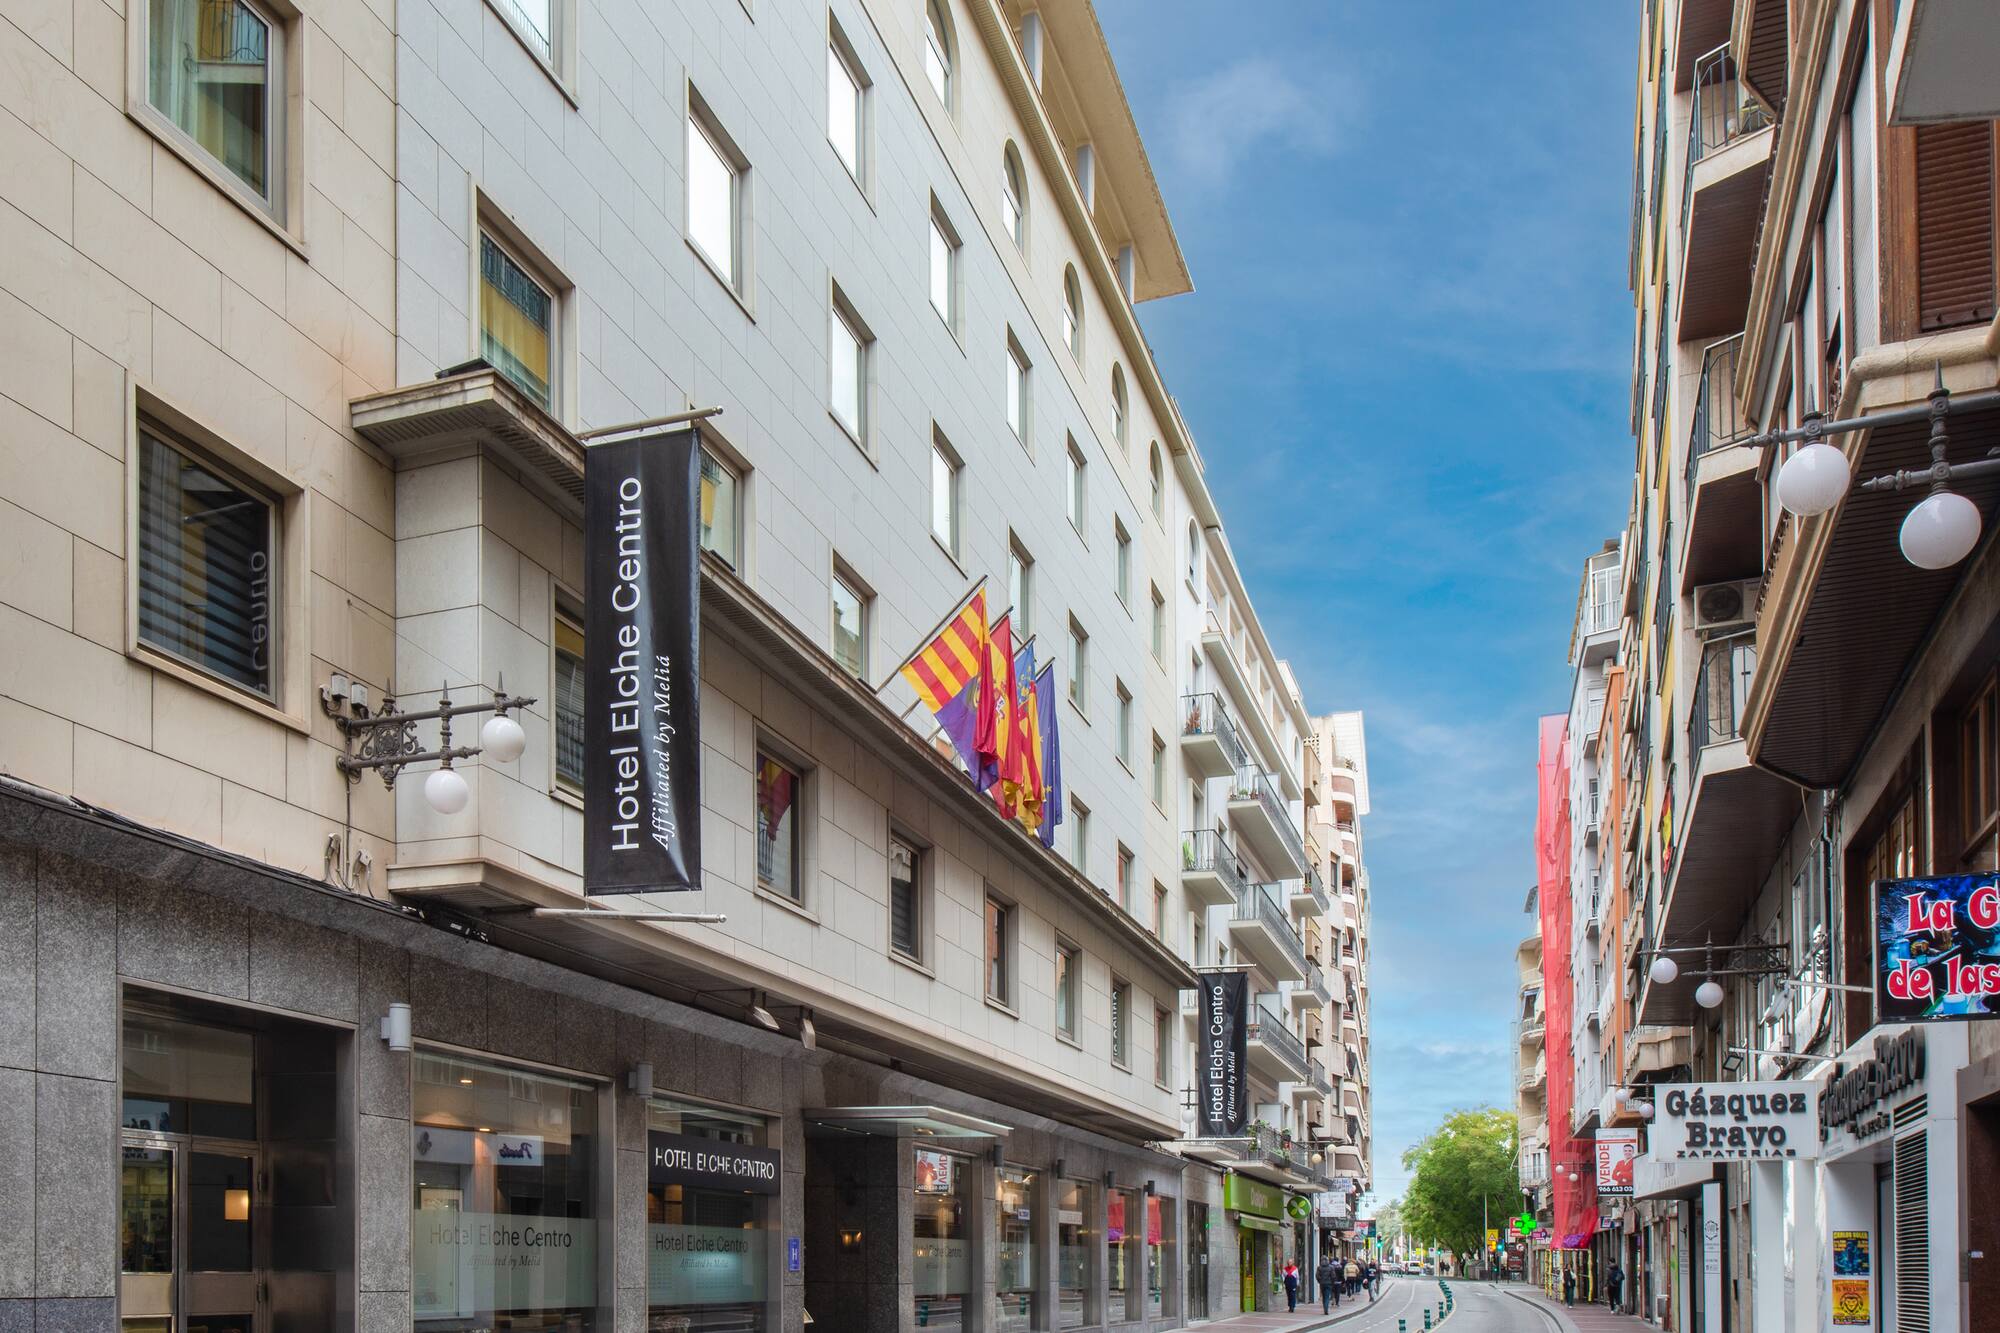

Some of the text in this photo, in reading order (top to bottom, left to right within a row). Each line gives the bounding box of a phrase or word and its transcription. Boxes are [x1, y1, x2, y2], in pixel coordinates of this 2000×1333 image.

[610, 477, 642, 851] Hotel Elche Centro
[651, 655, 676, 850] Affiliated by Meliá
[1902, 891, 1957, 938] La
[1887, 954, 2000, 1006] de las
[1210, 986, 1223, 1122] Hotel Elche Centro
[1665, 1087, 1806, 1121] Gázquez
[1685, 1121, 1786, 1147] Bravo
[655, 1147, 775, 1180] HOTEL ELCHE CENTRO
[1600, 1145, 1610, 1184] VENDE
[430, 1223, 572, 1248] Hotel Elche Centro
[656, 1233, 749, 1253] Hotel Elche Centro
